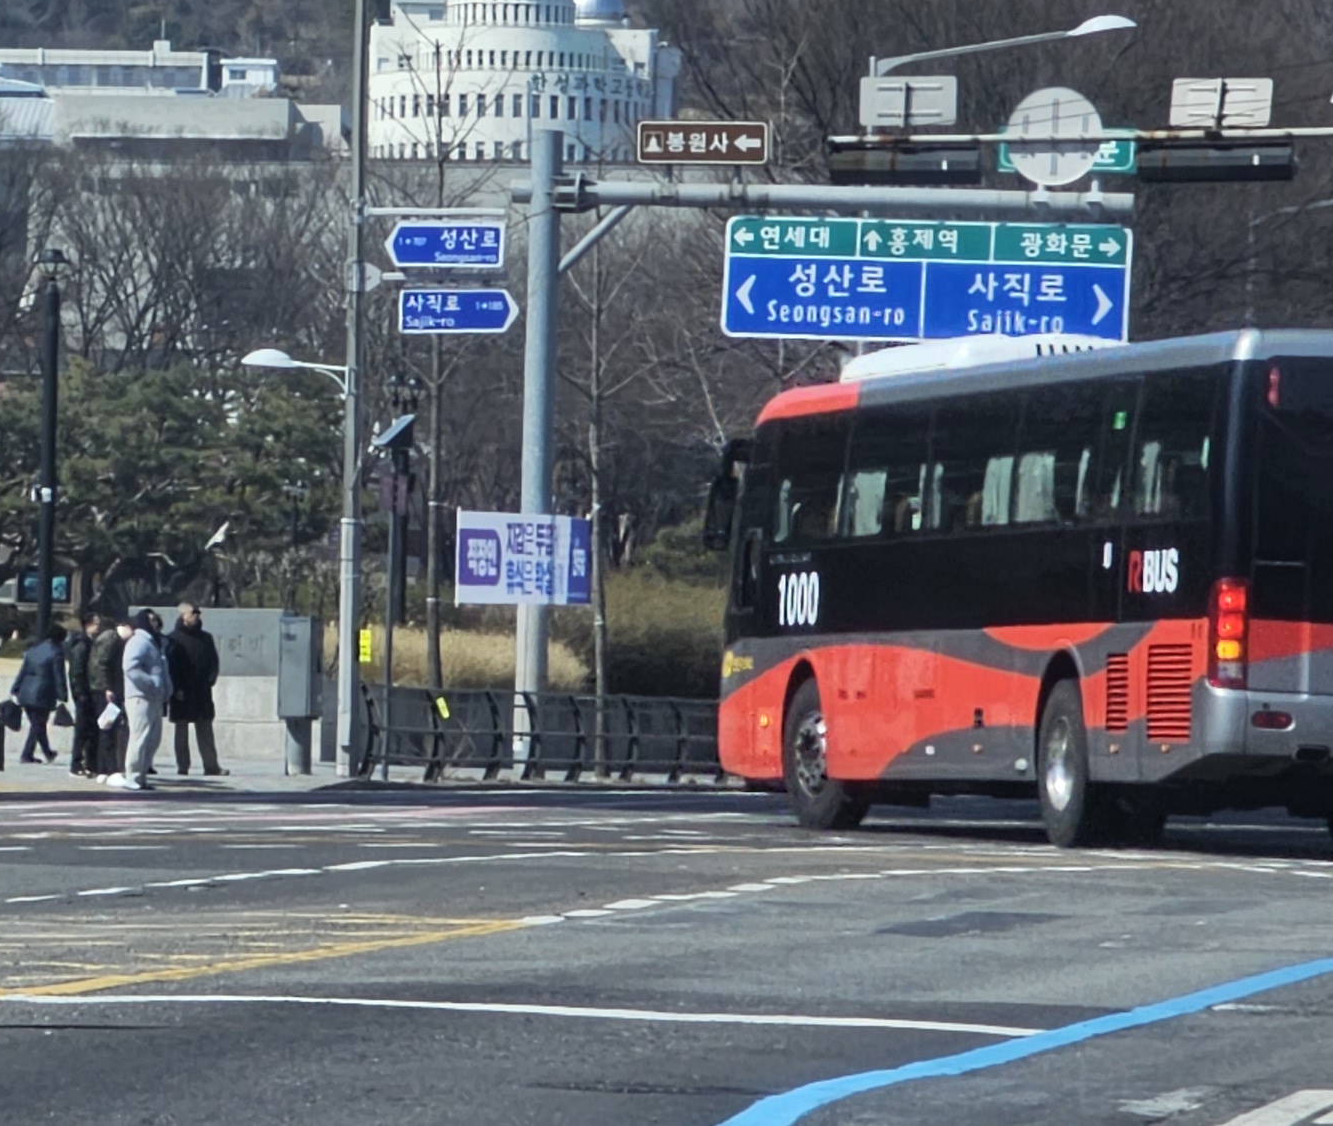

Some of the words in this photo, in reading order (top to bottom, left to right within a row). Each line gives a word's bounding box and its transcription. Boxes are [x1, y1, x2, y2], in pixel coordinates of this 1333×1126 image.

[665, 131, 730, 154] 봉원사
[439, 227, 499, 251] 성산로
[759, 225, 831, 250] 연세대
[887, 226, 959, 256] 홍제역
[1019, 232, 1094, 258] 광화문
[787, 263, 888, 298] 성산로
[967, 271, 1068, 308] 사직로
[405, 293, 462, 314] 사직로
[766, 299, 906, 328] Seongsan-ro
[404, 314, 456, 330] Sajik-ro
[966, 308, 1065, 334] Sajik-ro
[466, 537, 498, 577] 직장인
[777, 571, 821, 626] 1000
